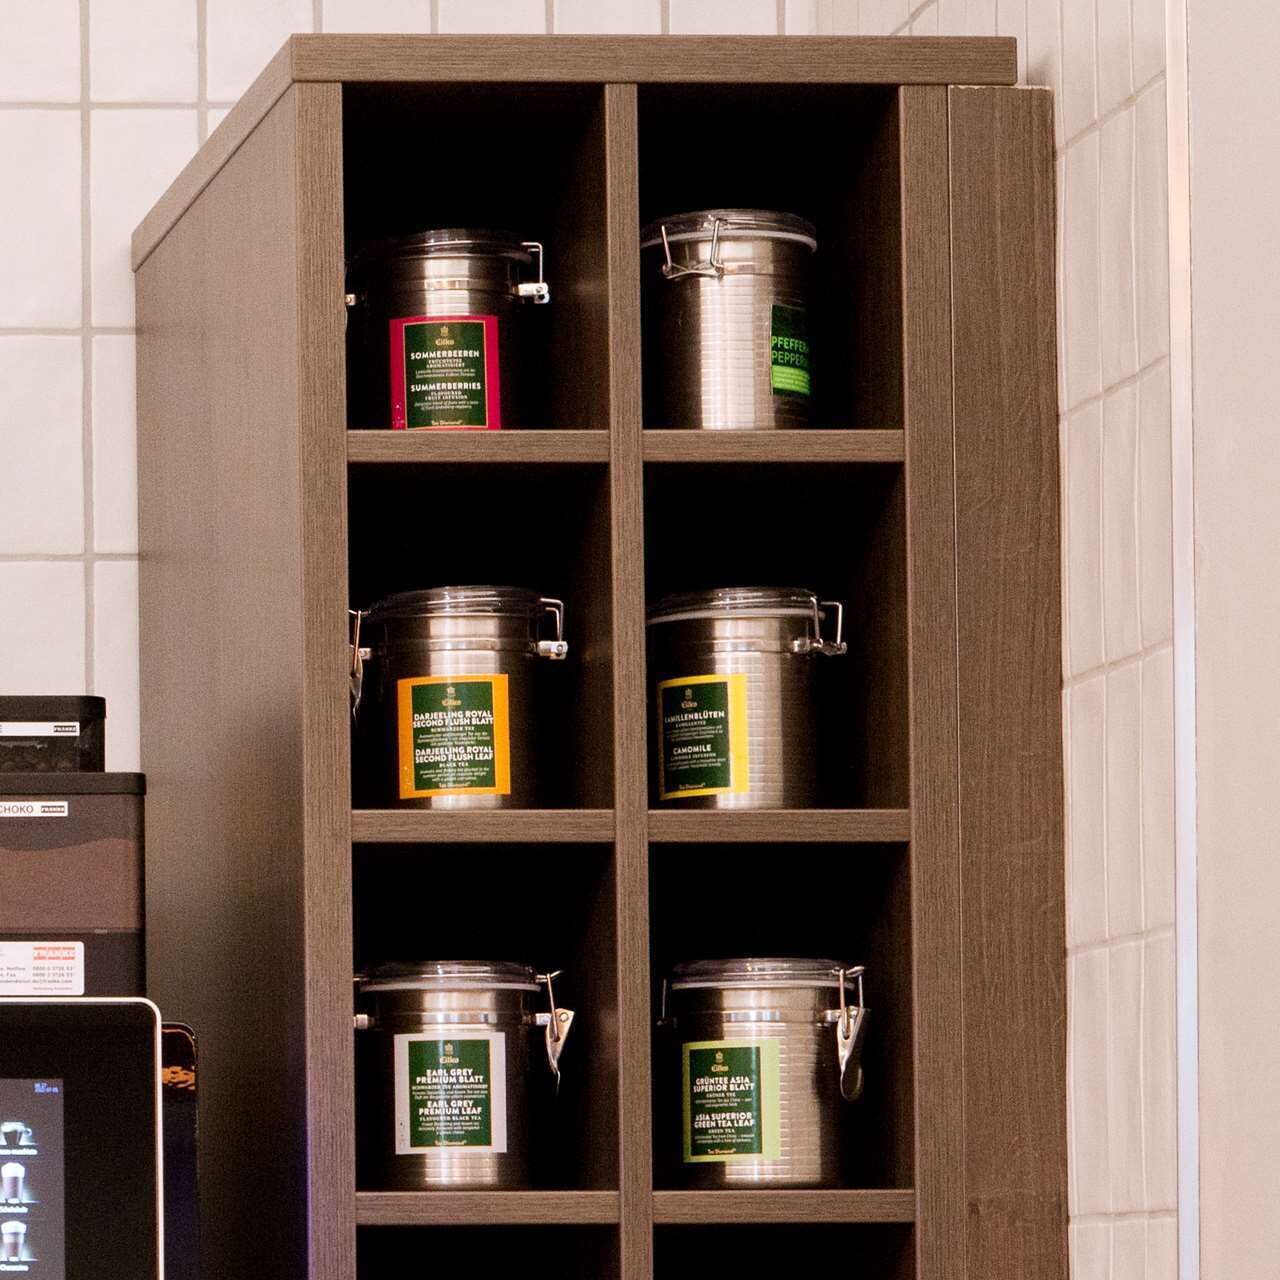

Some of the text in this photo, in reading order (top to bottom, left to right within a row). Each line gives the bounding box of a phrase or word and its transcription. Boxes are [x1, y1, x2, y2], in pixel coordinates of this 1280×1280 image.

[410, 351, 479, 359] SOMMERBEEREN
[411, 383, 481, 391] SUMMERBERRIES
[414, 710, 492, 720] DARJEELING ROYAL
[413, 717, 494, 728] SECOND FLUSH BLATT
[415, 746, 493, 756] DARJEELING ROYAL
[673, 745, 712, 754] CAMOMILE
[415, 754, 447, 764] SECOND
[448, 754, 474, 762] FLUSH
[426, 1068, 473, 1076] EARL GREY
[416, 1076, 457, 1084] PREMIUM
[696, 1076, 750, 1085] GRÜNTEE ASIA
[693, 1083, 754, 1092] SUPERIOR BLATT
[427, 1100, 474, 1108] EARL GREY
[696, 1112, 752, 1121] ASIA SUPERIOR
[694, 1120, 716, 1128] GREEN
[718, 1120, 732, 1128] TEA
